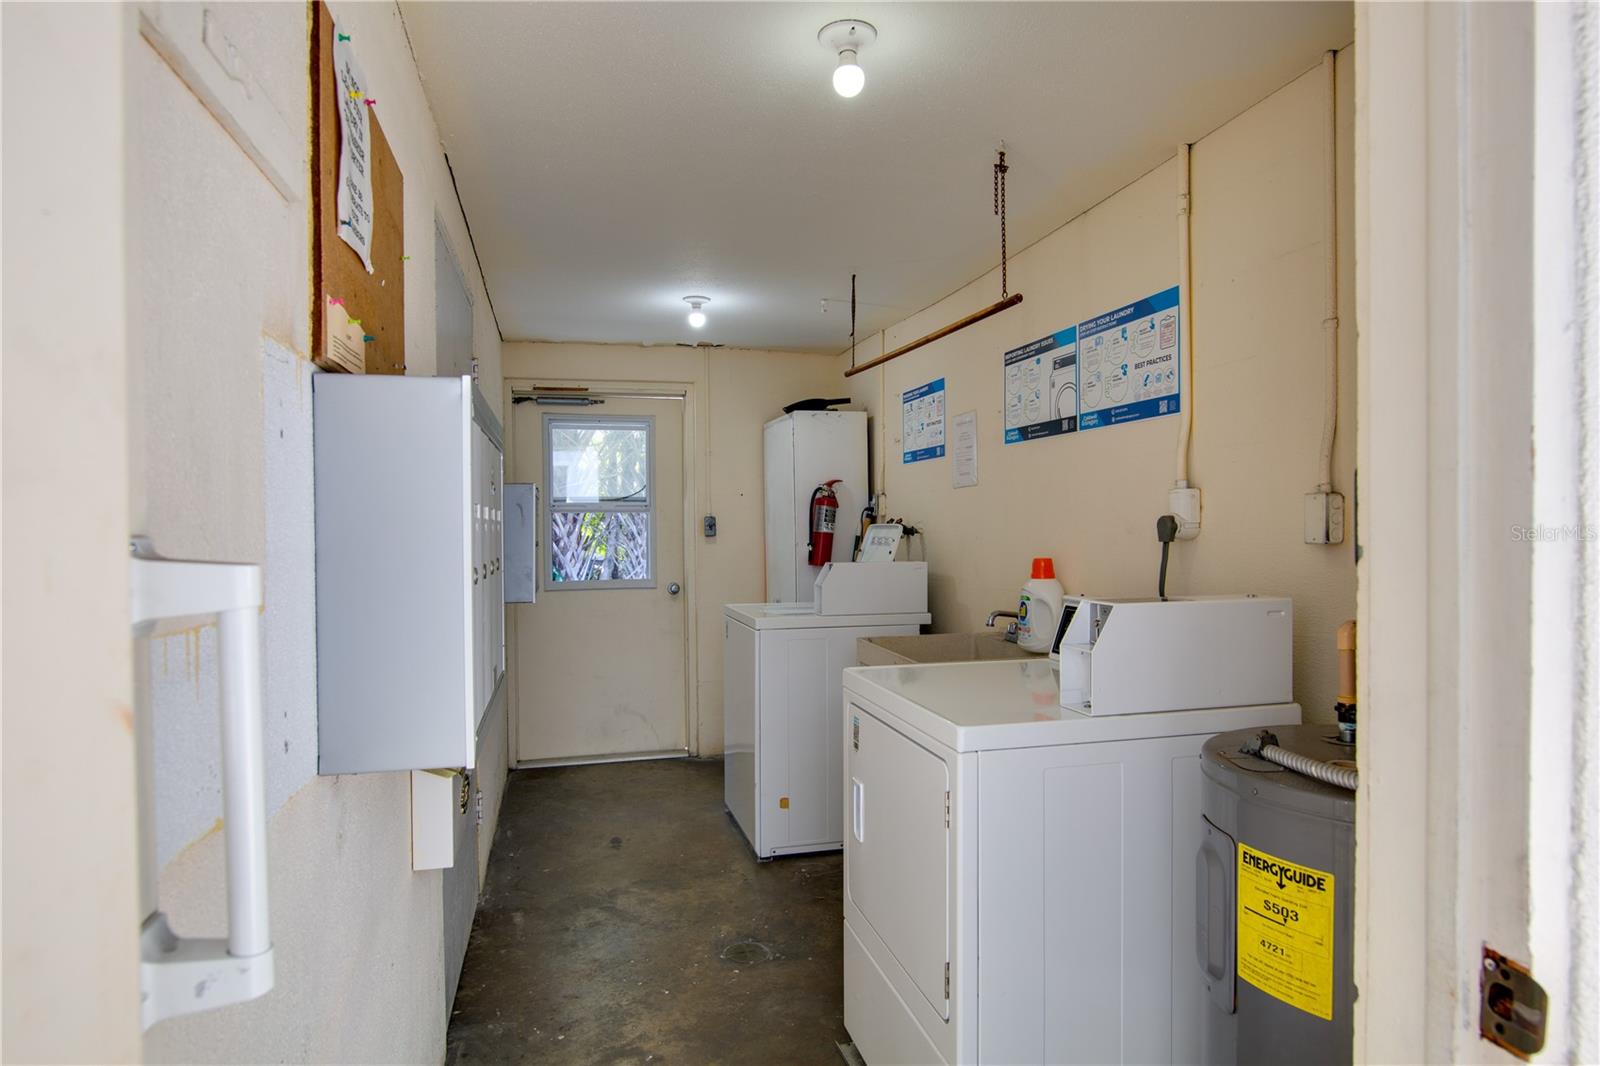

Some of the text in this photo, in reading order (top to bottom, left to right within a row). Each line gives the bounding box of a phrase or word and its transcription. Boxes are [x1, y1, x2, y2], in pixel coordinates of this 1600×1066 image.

[1097, 316, 1111, 326] YOUR
[1111, 307, 1134, 321] LAUNDRY
[1134, 353, 1172, 370] BEST PRACTICES
[1243, 850, 1326, 892] ENERGYGUIDE
[1260, 939, 1285, 956] 4721
